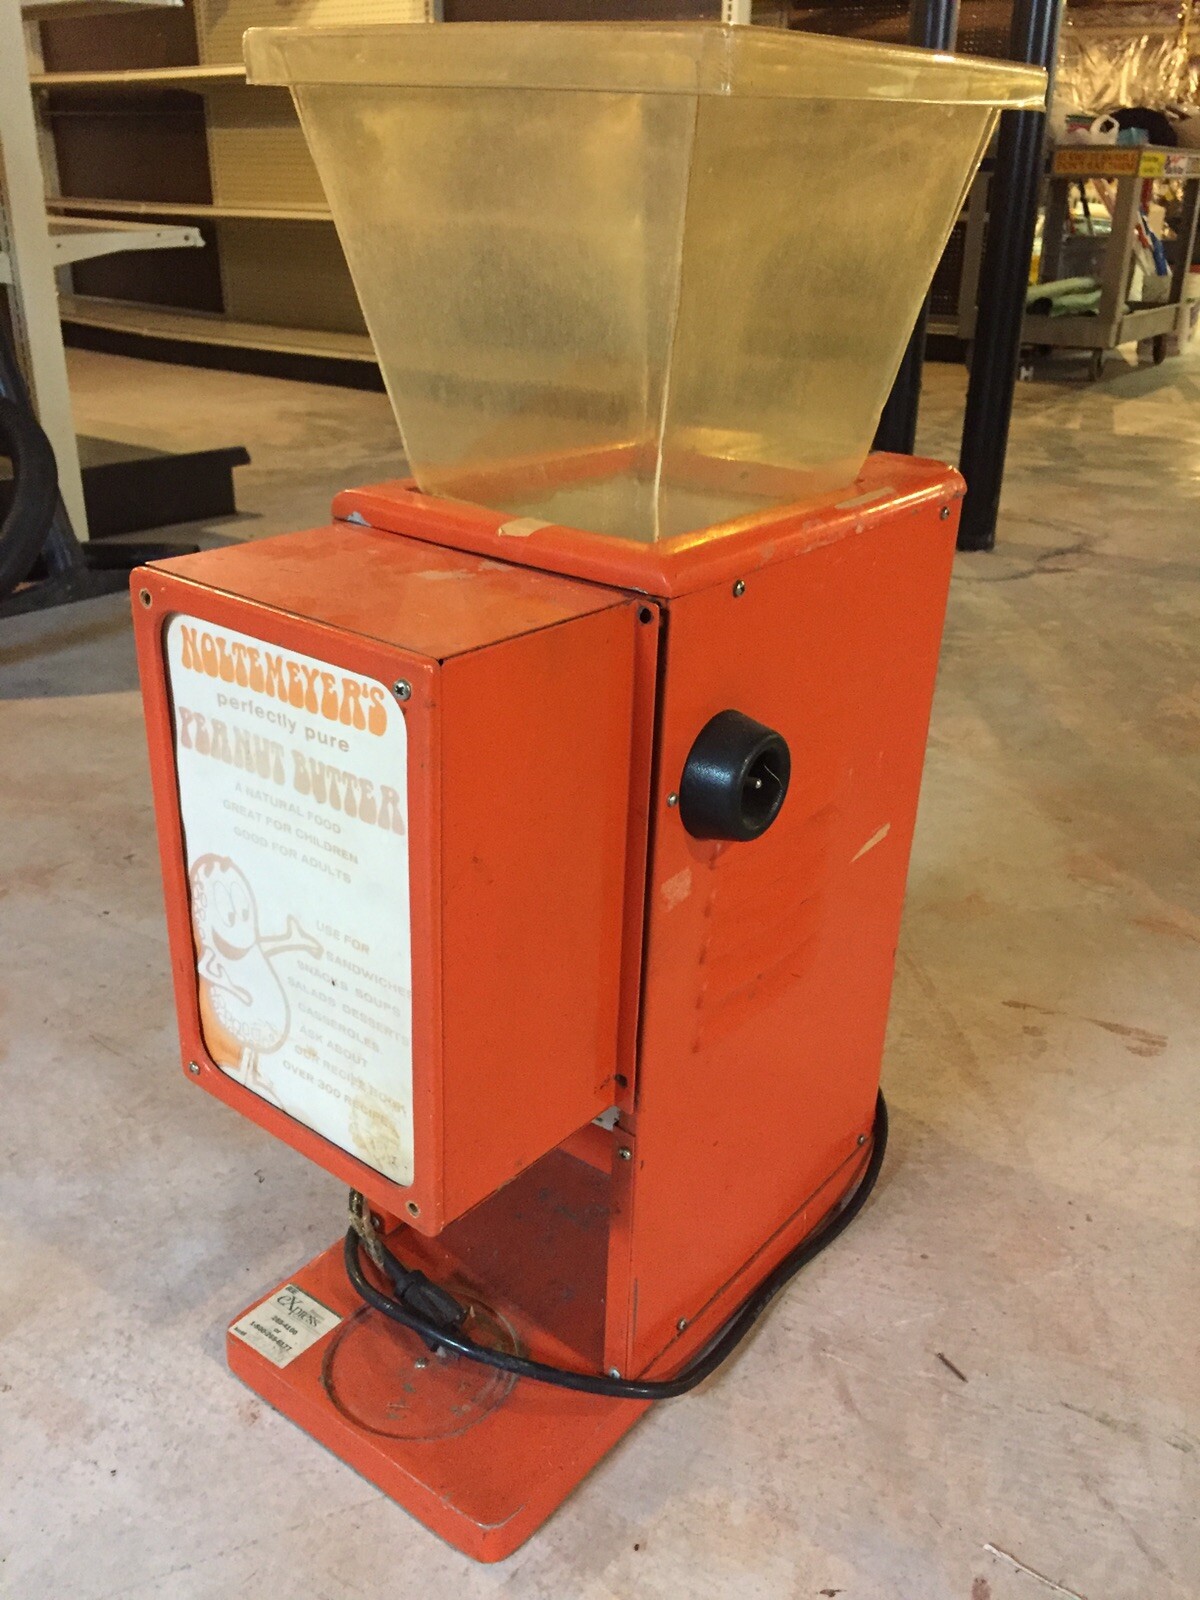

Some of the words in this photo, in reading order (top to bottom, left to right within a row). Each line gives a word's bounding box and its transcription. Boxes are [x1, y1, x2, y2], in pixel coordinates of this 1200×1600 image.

[180, 624, 388, 737] NOLTEMEYER'S
[217, 693, 296, 735] perfectly
[305, 726, 350, 752] pure
[179, 706, 285, 786] PEANUT
[291, 749, 406, 836] BUTTER
[223, 799, 262, 823] GREAT
[266, 816, 292, 835] FOR
[296, 827, 359, 865] CHILDREN
[235, 782, 242, 792] A
[245, 787, 304, 818] NATURAL
[307, 811, 342, 834] FOOD
[234, 826, 268, 848] GOOD
[272, 842, 298, 860] FOR
[301, 854, 352, 884] ADULTS
[316, 920, 341, 941] USE
[344, 934, 370, 955] FOR
[287, 976, 337, 1008] SALADS
[342, 1003, 410, 1047] DESSERTS
[297, 960, 349, 992] SNACKS
[355, 987, 401, 1018] SOUPS
[299, 1025, 323, 1044] ASK
[326, 1040, 368, 1068] ABOUT
[283, 1059, 314, 1084] OVER
[317, 1080, 341, 1099] 300
